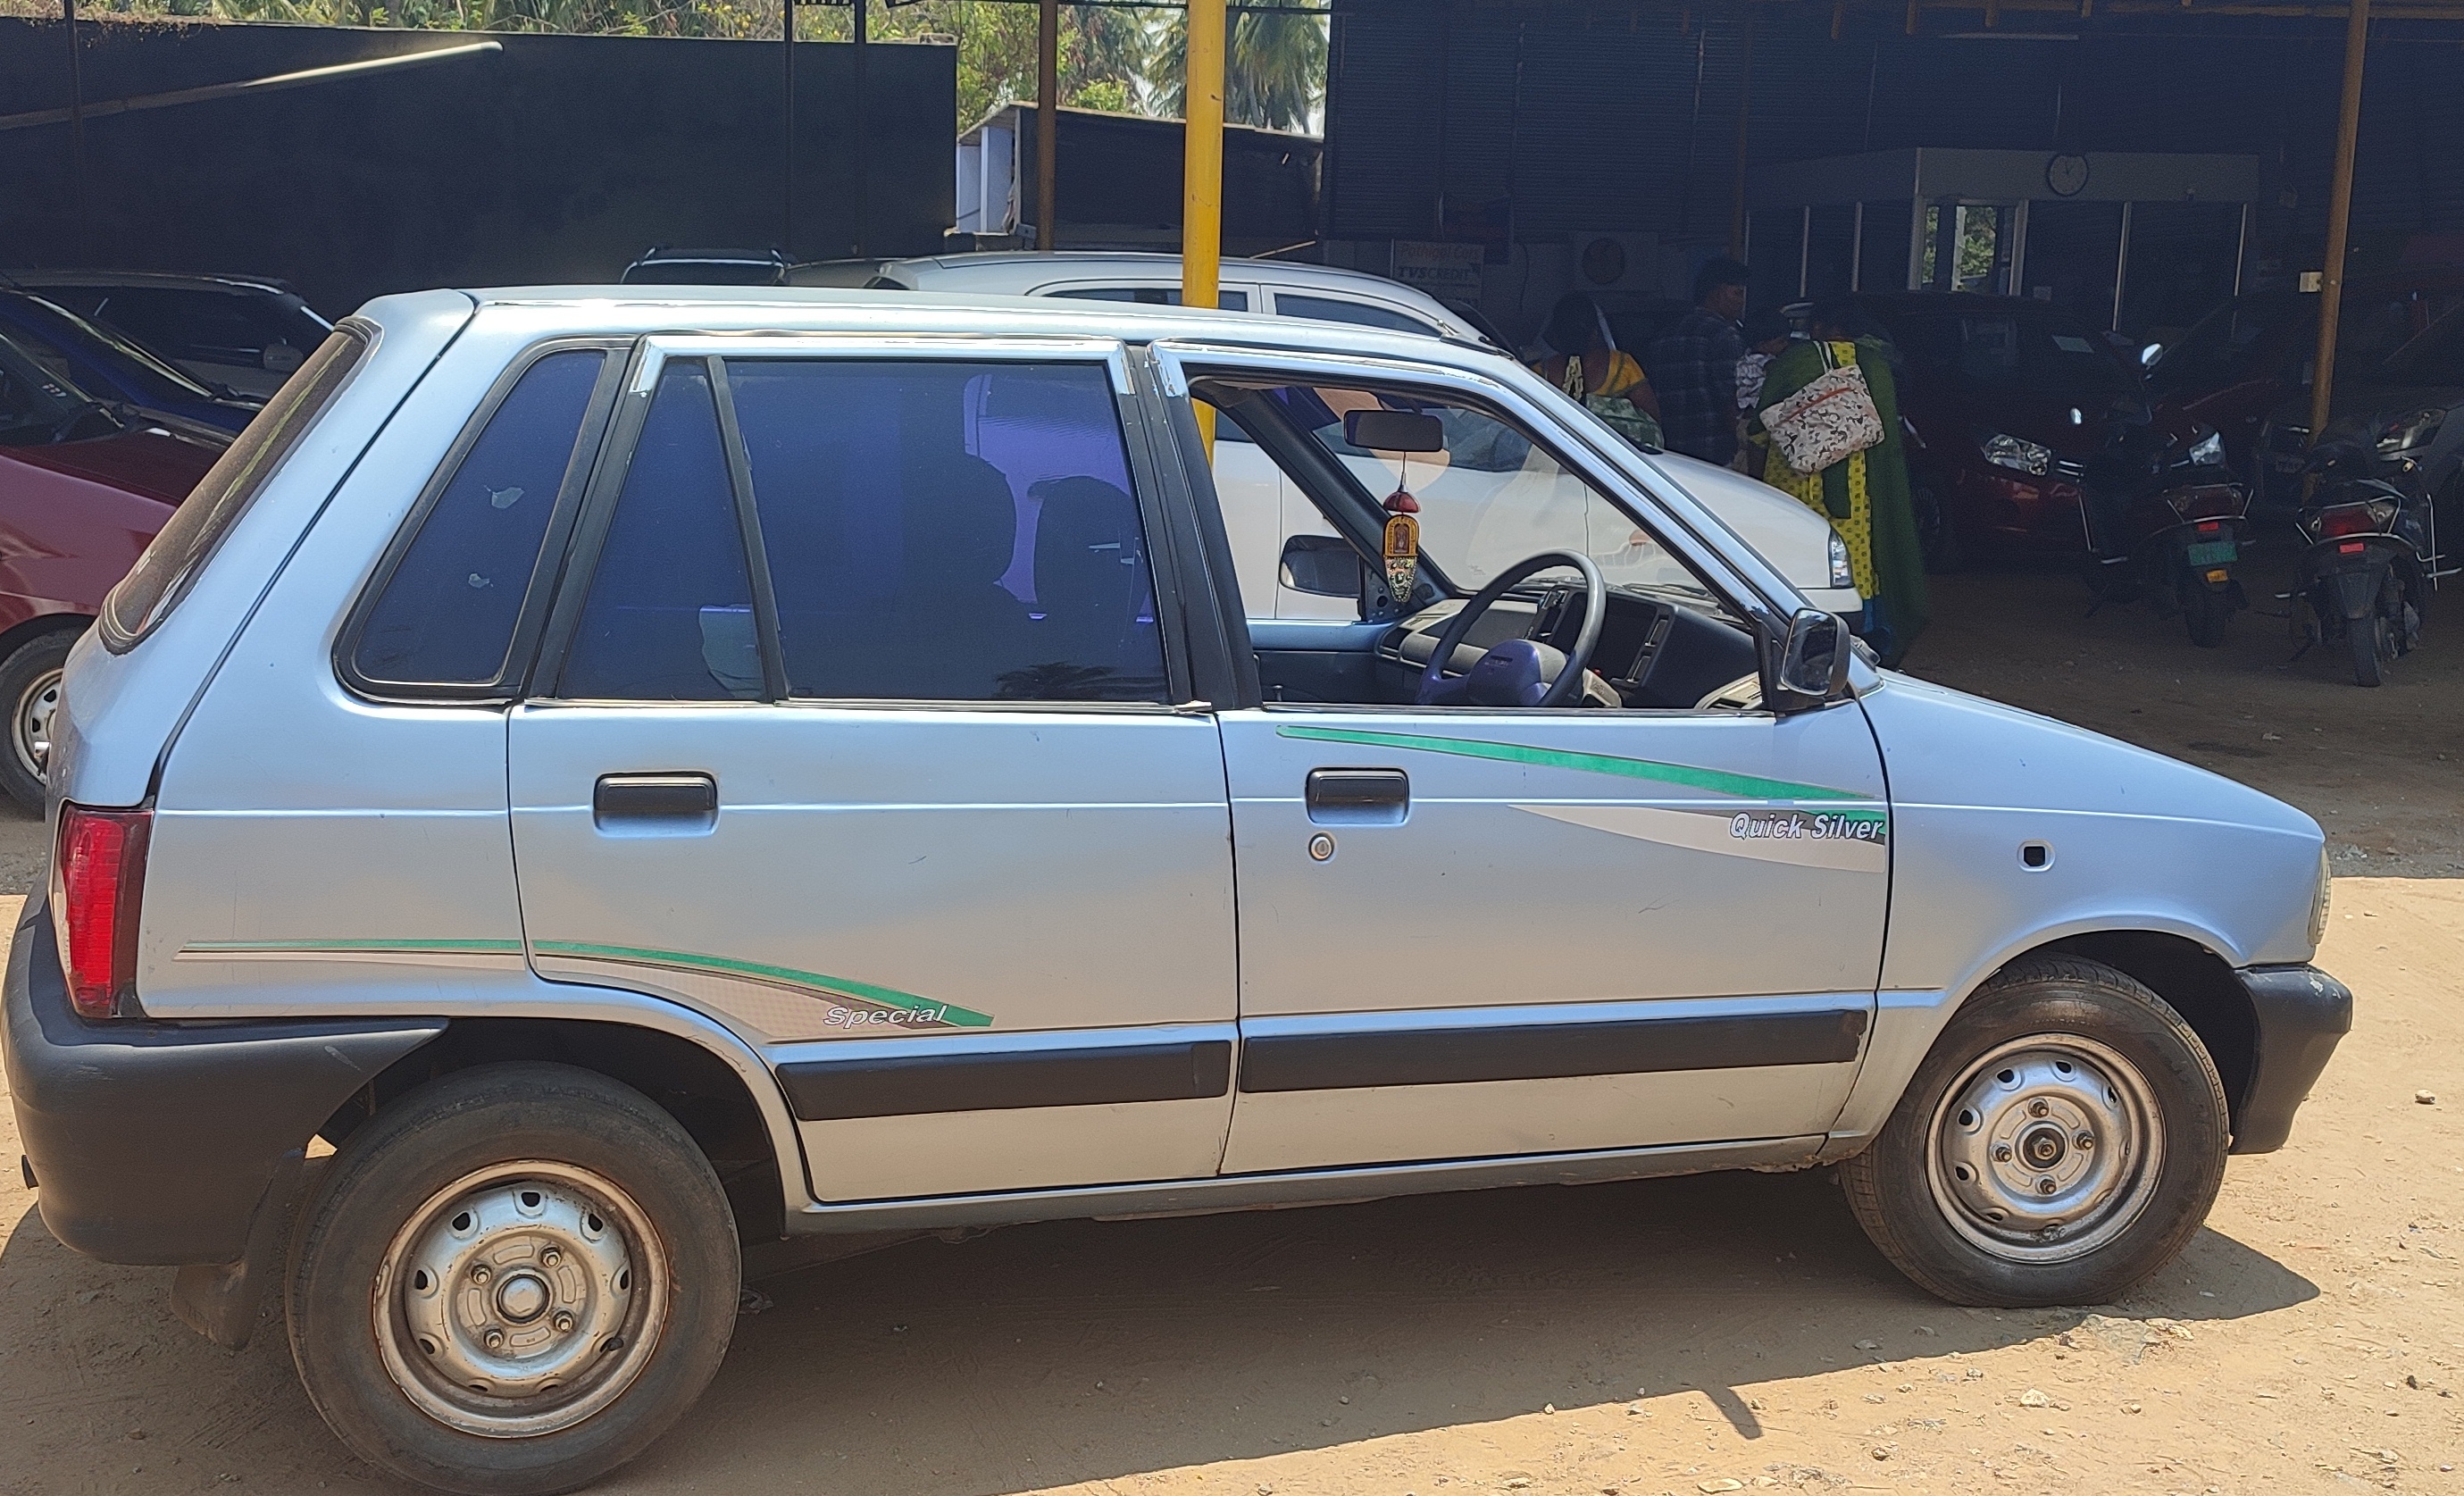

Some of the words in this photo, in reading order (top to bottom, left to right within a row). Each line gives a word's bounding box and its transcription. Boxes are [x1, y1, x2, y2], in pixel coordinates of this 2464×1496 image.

[1729, 811, 1806, 840] Quick
[1809, 812, 1885, 840] Silver
[823, 1003, 950, 1030] Special
